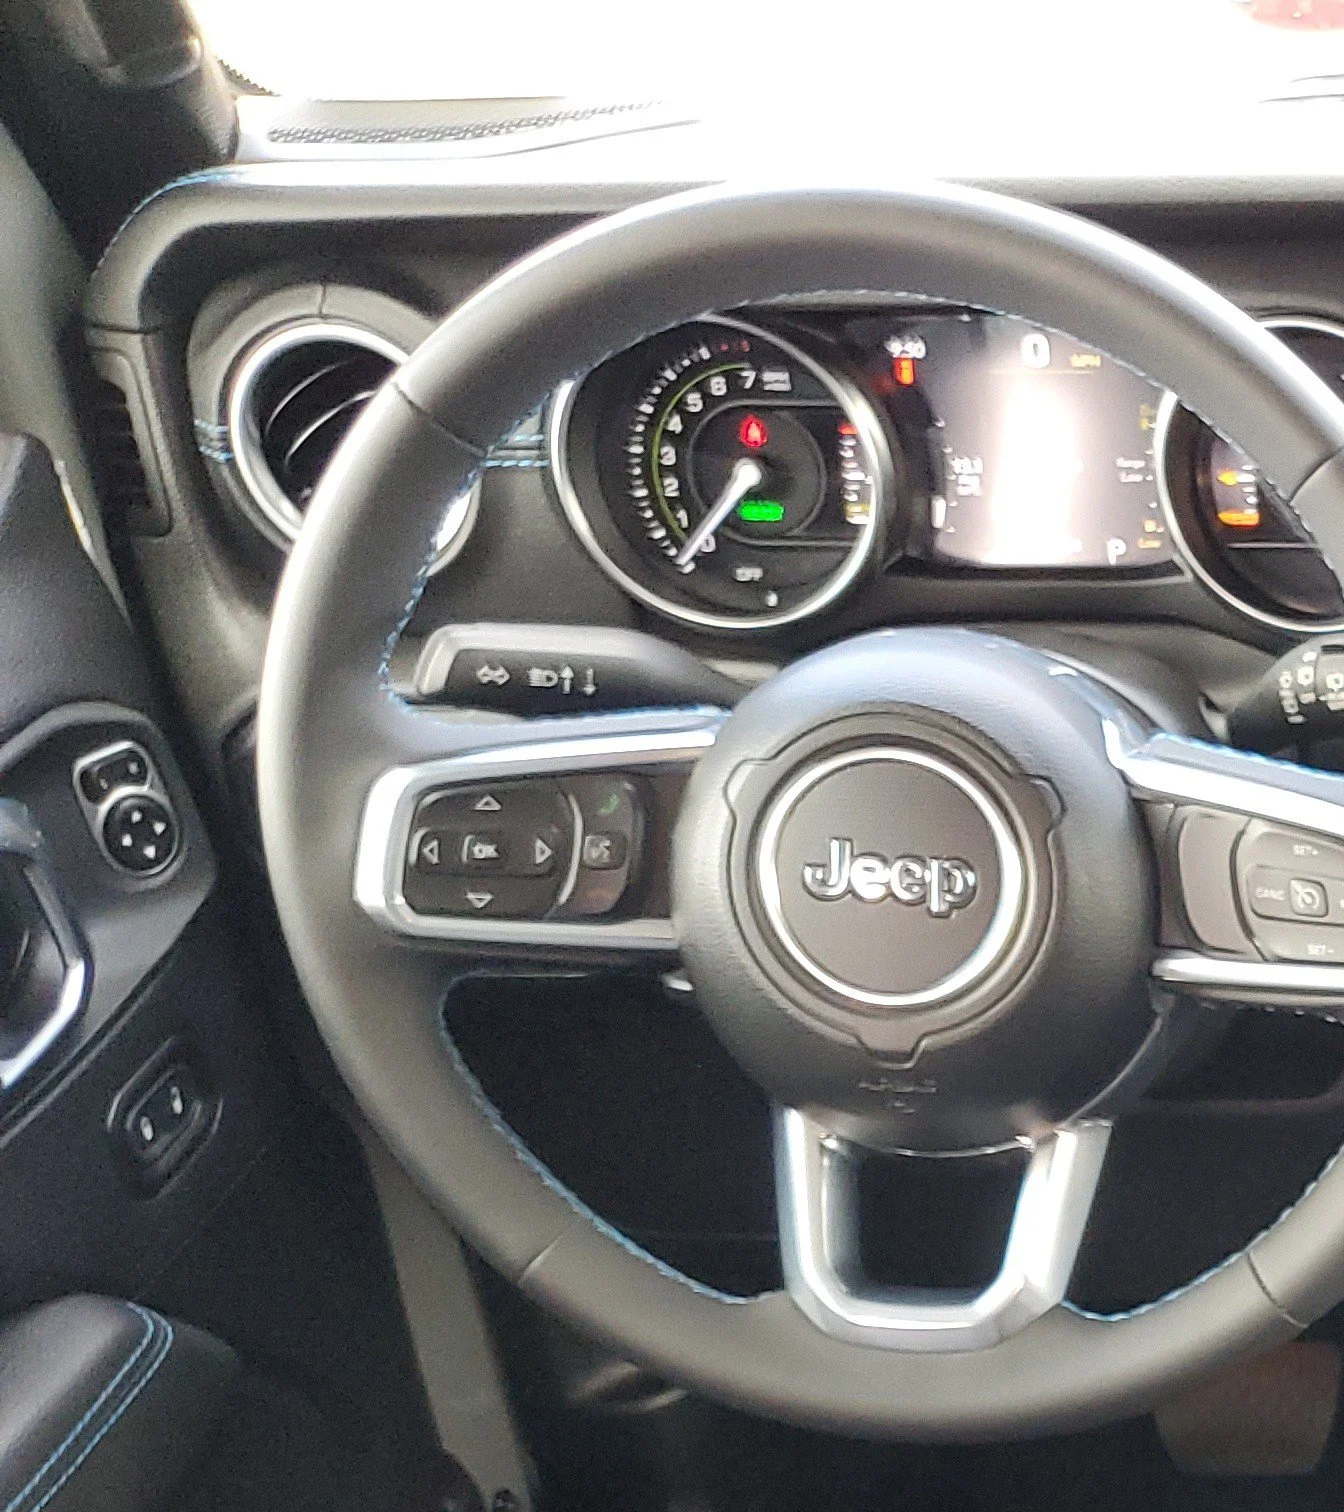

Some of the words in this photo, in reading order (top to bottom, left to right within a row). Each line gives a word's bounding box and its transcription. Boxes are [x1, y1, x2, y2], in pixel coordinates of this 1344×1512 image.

[742, 370, 756, 389] 7
[686, 393, 703, 413] 5
[667, 414, 683, 434] 4
[660, 446, 677, 466] 3
[664, 477, 680, 497] 2
[676, 508, 689, 529] 1
[1106, 537, 1127, 565] P
[802, 837, 977, 918] Jeep
